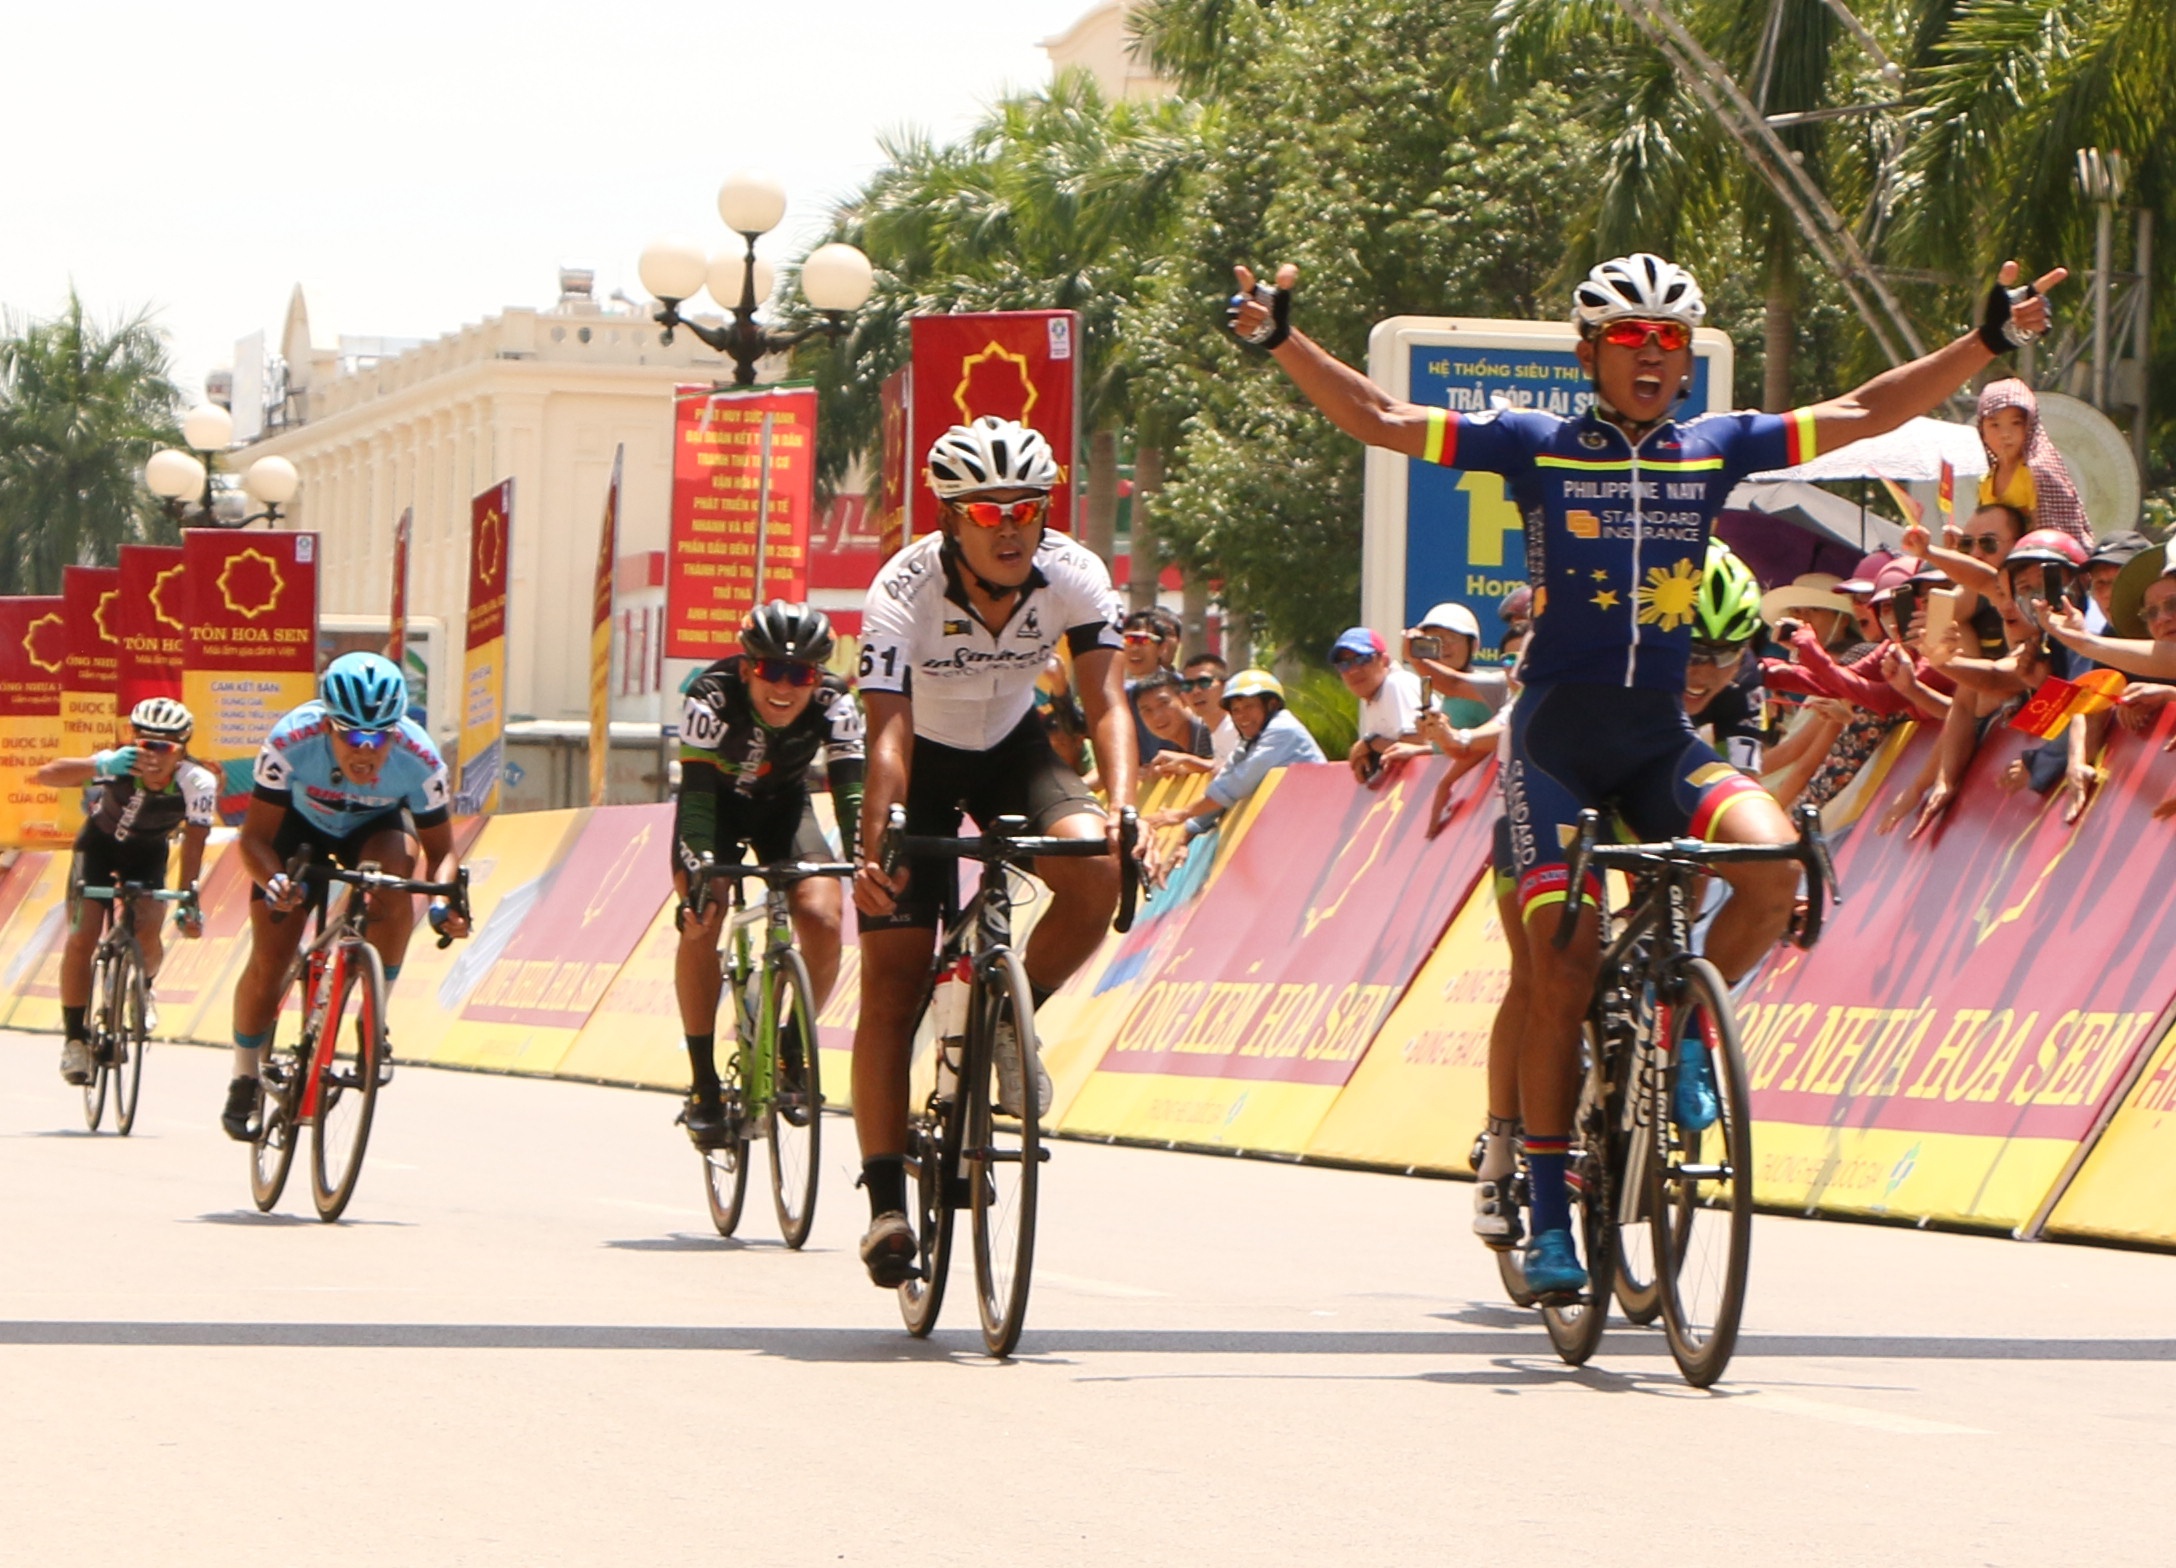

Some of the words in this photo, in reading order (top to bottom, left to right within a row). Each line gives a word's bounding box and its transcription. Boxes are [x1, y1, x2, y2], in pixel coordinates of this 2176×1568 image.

[1428, 358, 1450, 378] HỆ
[1453, 357, 1511, 377] THỐNG
[1514, 361, 1550, 379] SIÊU
[1446, 380, 1486, 411] TRẢ
[1666, 482, 1707, 500] NAVY
[1602, 510, 1702, 526] STANDARD
[123, 633, 159, 651] TÔN
[190, 621, 226, 640] TÔN
[232, 627, 270, 641] HOA
[273, 628, 310, 643] SEN
[859, 643, 897, 678] 61
[1740, 738, 1756, 768] 7
[1239, 981, 1334, 1060] HOA
[1904, 1006, 2040, 1103] HOA
[2005, 1007, 2158, 1106] SEN
